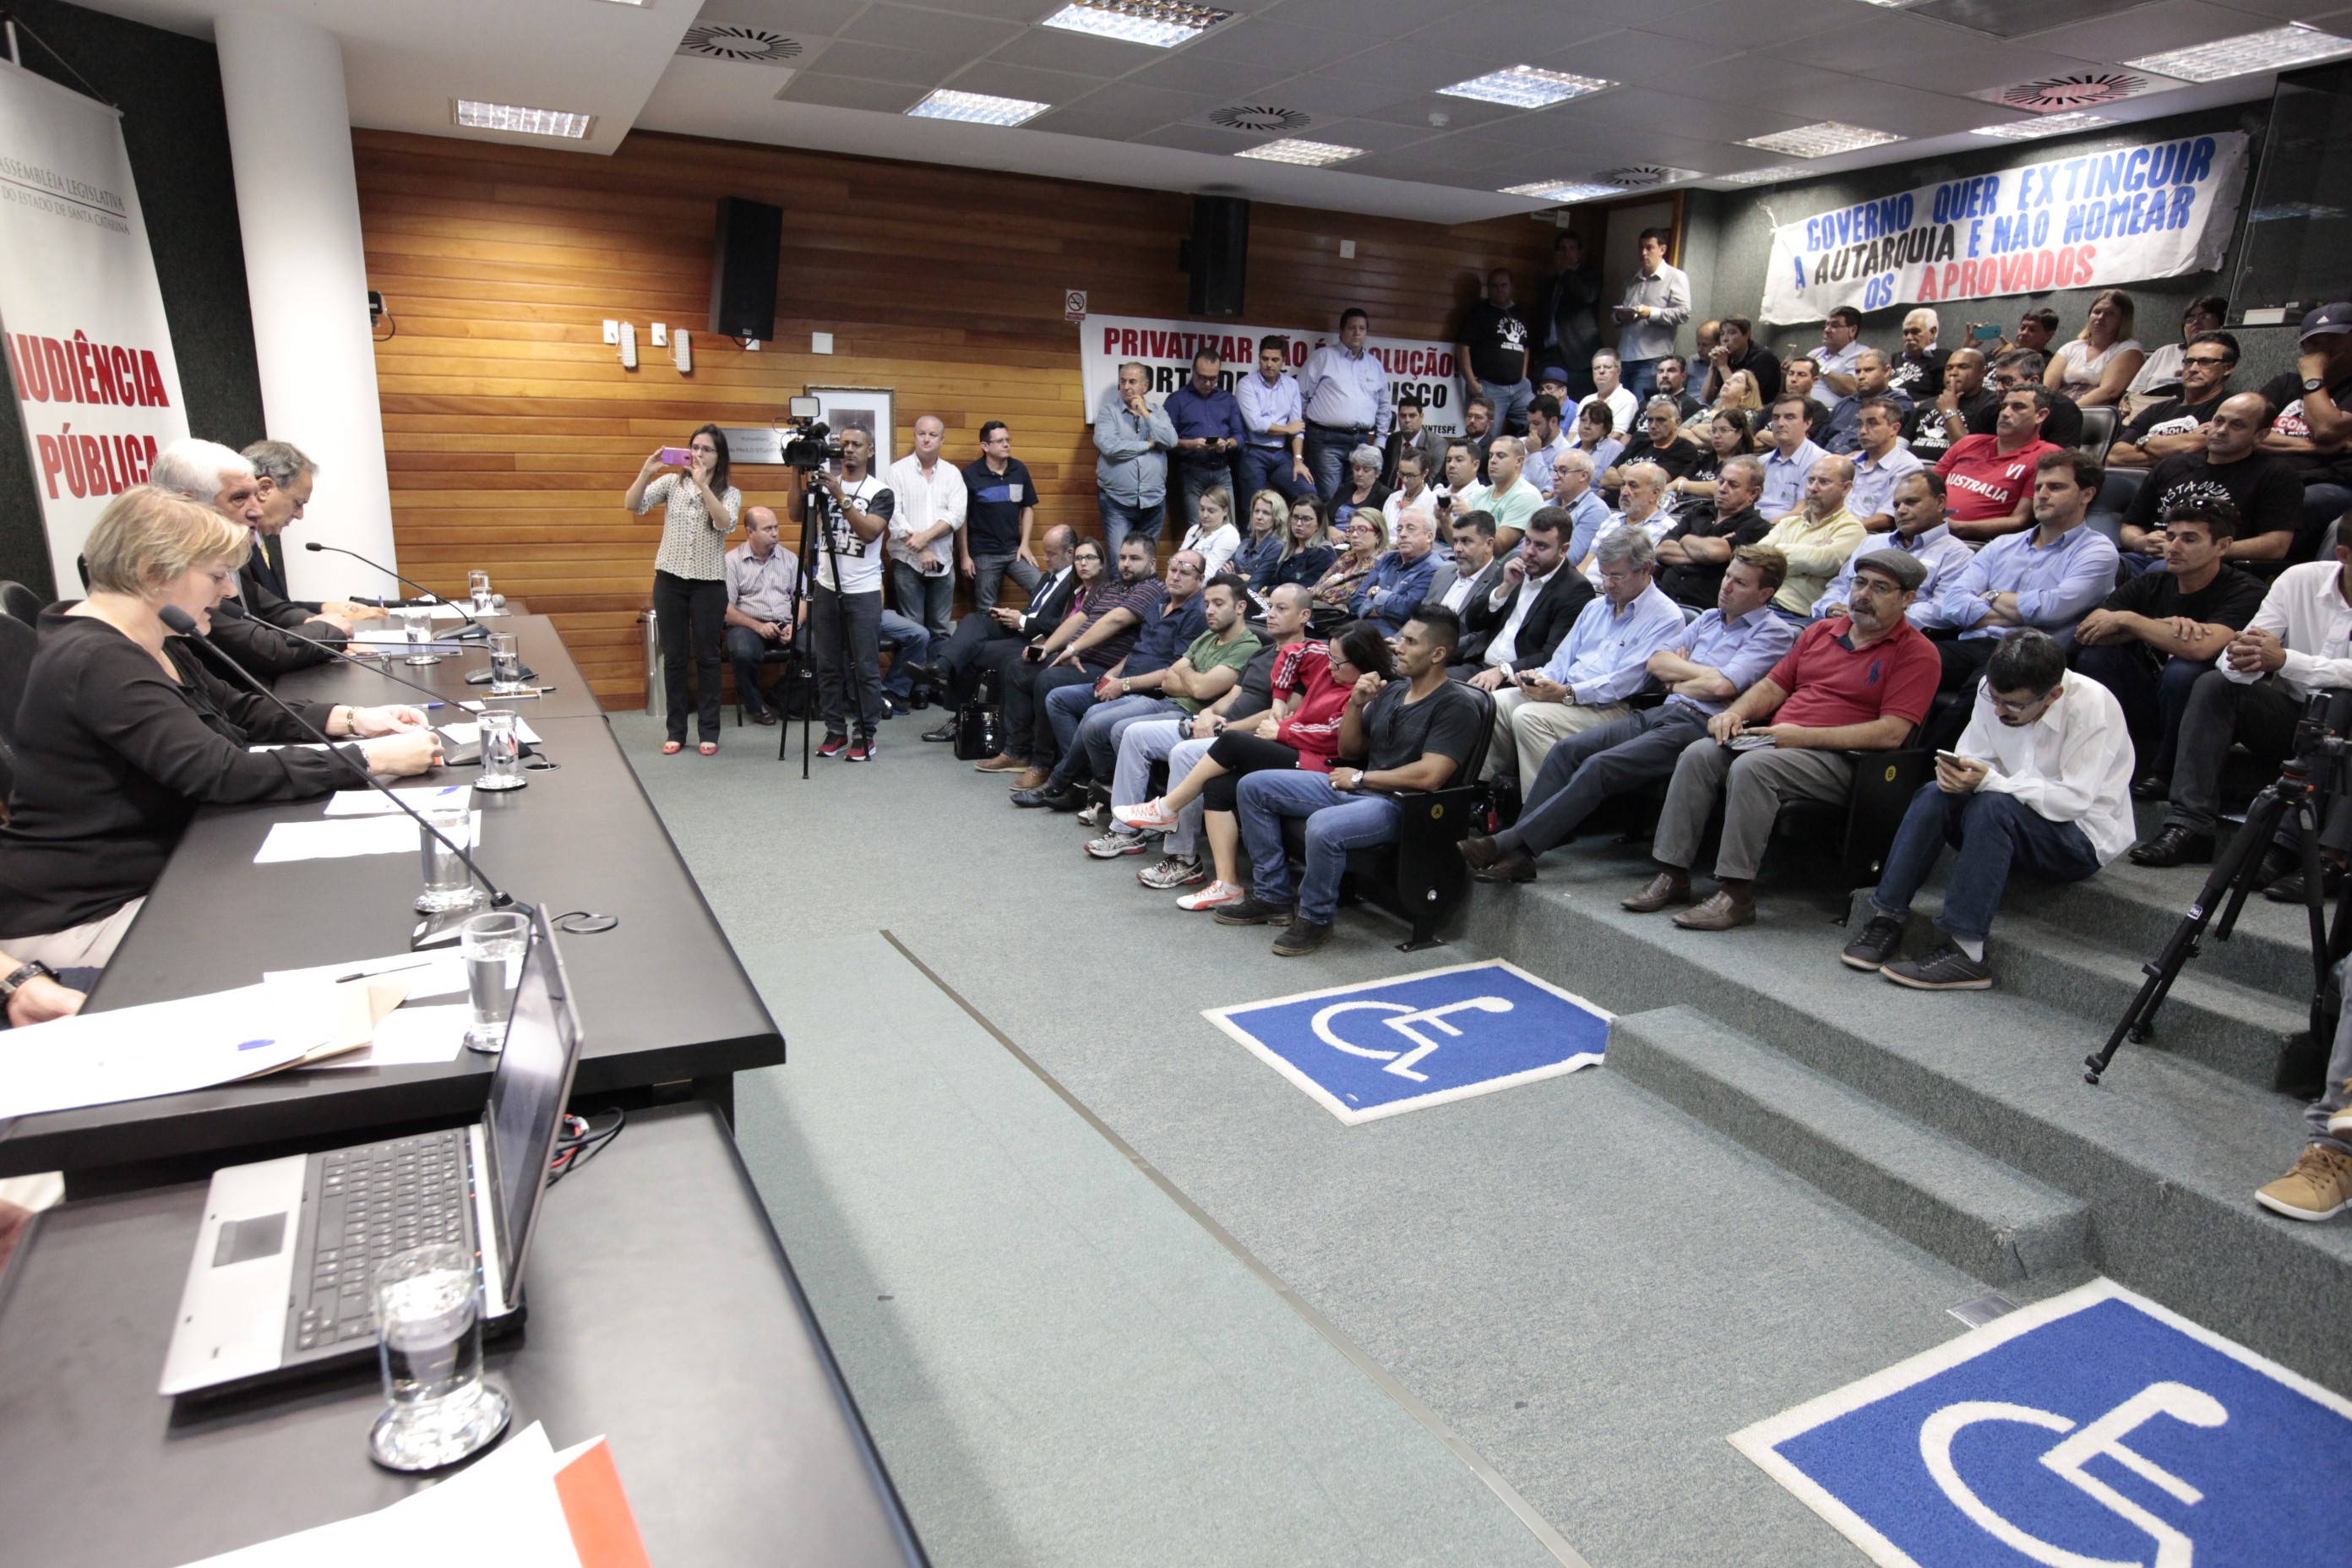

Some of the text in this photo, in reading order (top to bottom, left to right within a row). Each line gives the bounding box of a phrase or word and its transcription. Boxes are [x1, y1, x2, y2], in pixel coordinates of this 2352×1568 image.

[2, 185, 131, 235] DO ESTADO DE SANTA CATARINA
[66, 177, 126, 211] LEGISLATIVA
[1806, 136, 2217, 253] GOVERNO QUER EXTINGUIR
[1794, 255, 1806, 291] A
[1815, 223, 1955, 286] AUTARQUIA
[1967, 220, 1984, 259] E
[2062, 185, 2197, 245] NOMEAR
[1864, 243, 2097, 311] OS APROVADOS
[1103, 327, 1253, 364] PRIVATIZAR
[1422, 424, 1457, 435] INTESPE
[1946, 472, 2009, 504] AUSTRALIA
